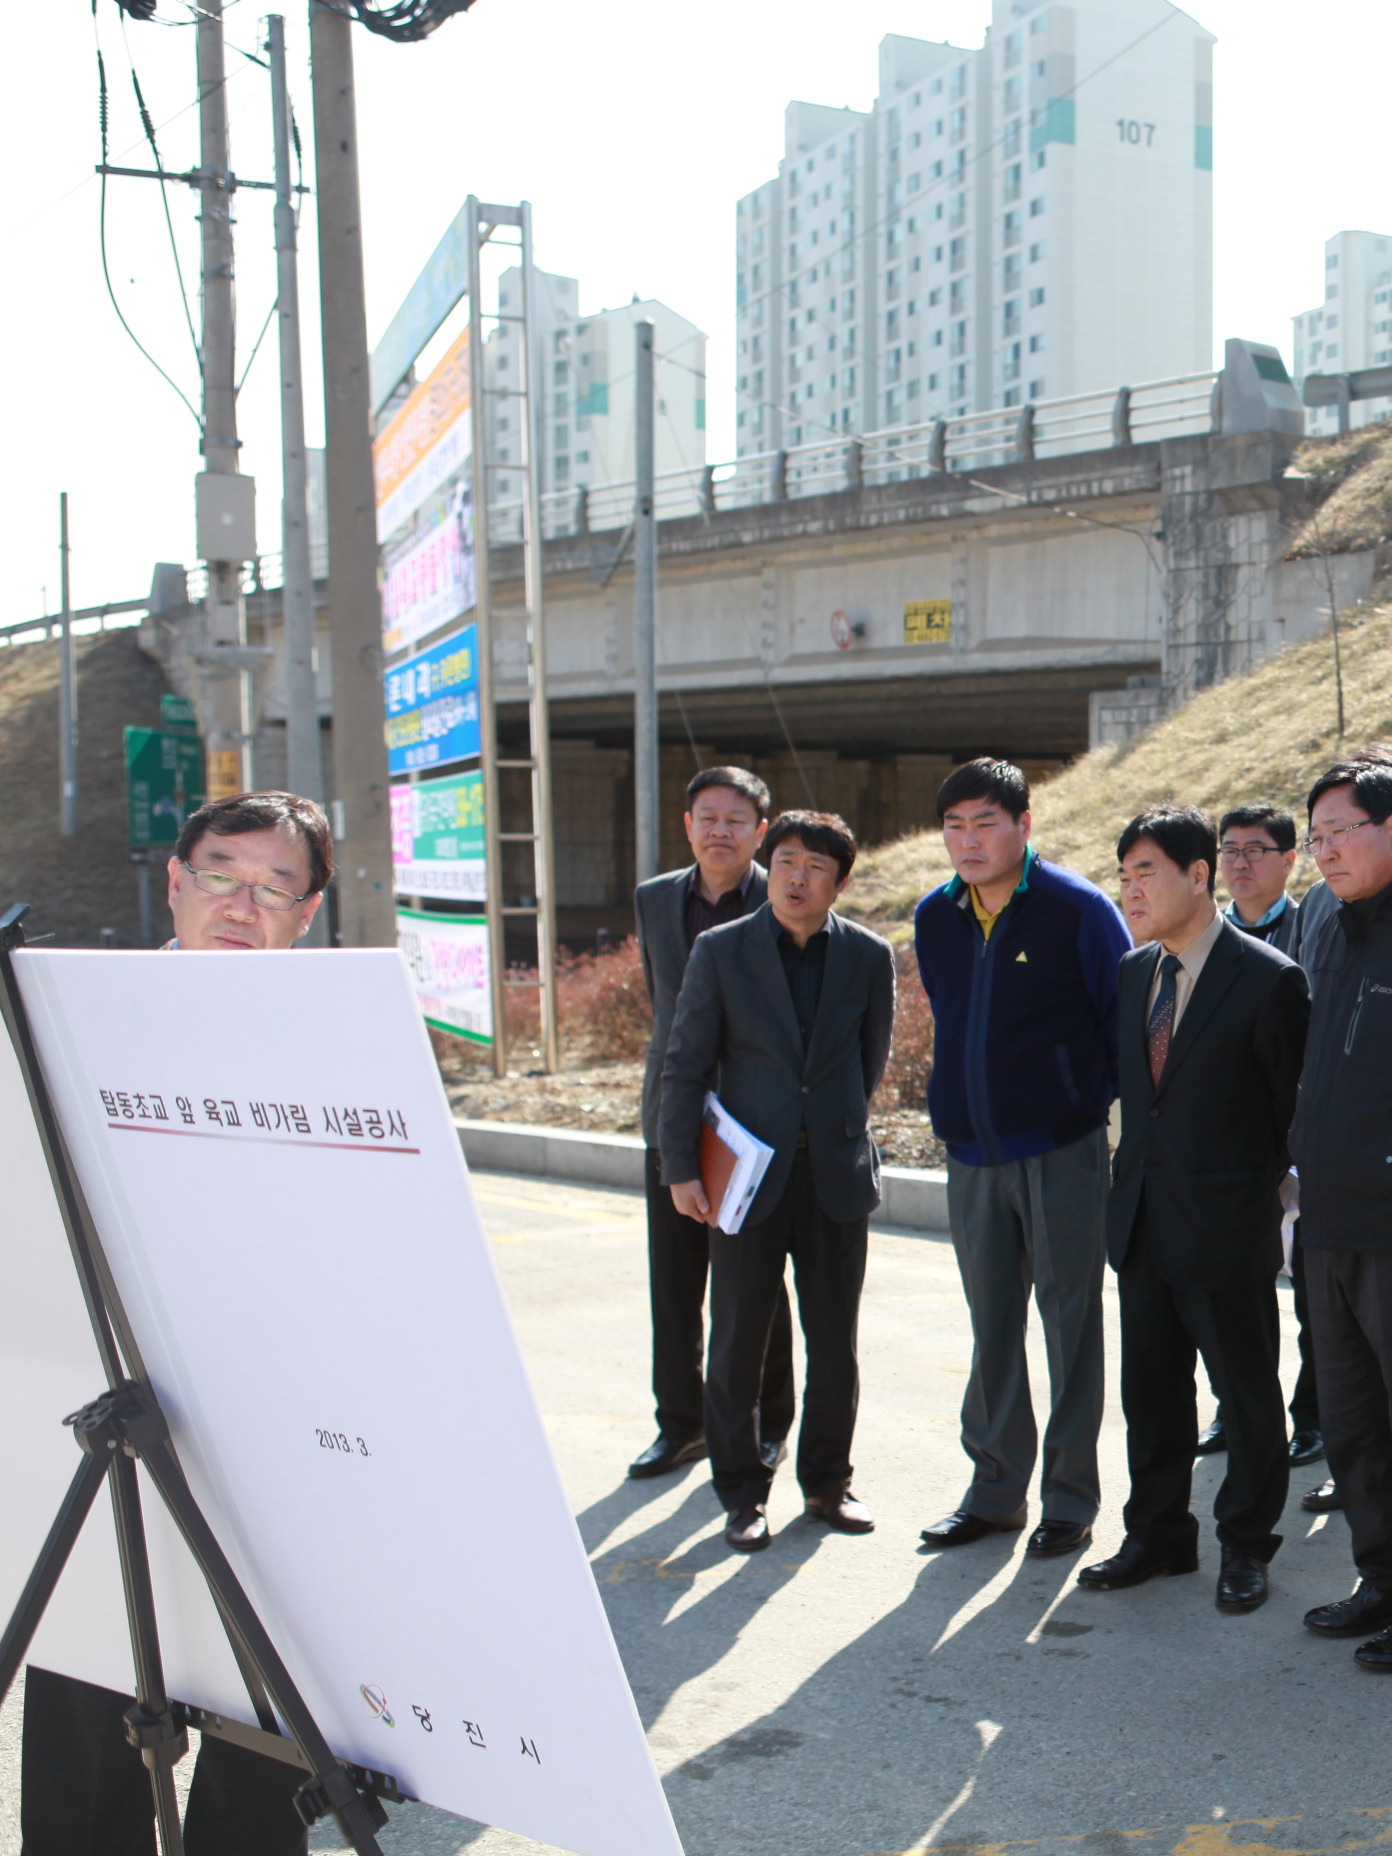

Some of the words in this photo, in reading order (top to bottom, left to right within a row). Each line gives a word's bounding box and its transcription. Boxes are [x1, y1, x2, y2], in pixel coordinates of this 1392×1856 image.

[1115, 118, 1156, 147] 107
[99, 1089, 169, 1121] 탑동초교
[175, 1096, 196, 1125] 앞
[203, 1098, 242, 1127] 육교
[249, 1101, 312, 1134] 비가림
[323, 1106, 409, 1140] 시설공사
[315, 1428, 354, 1453] 2013.
[356, 1436, 372, 1457] 3.
